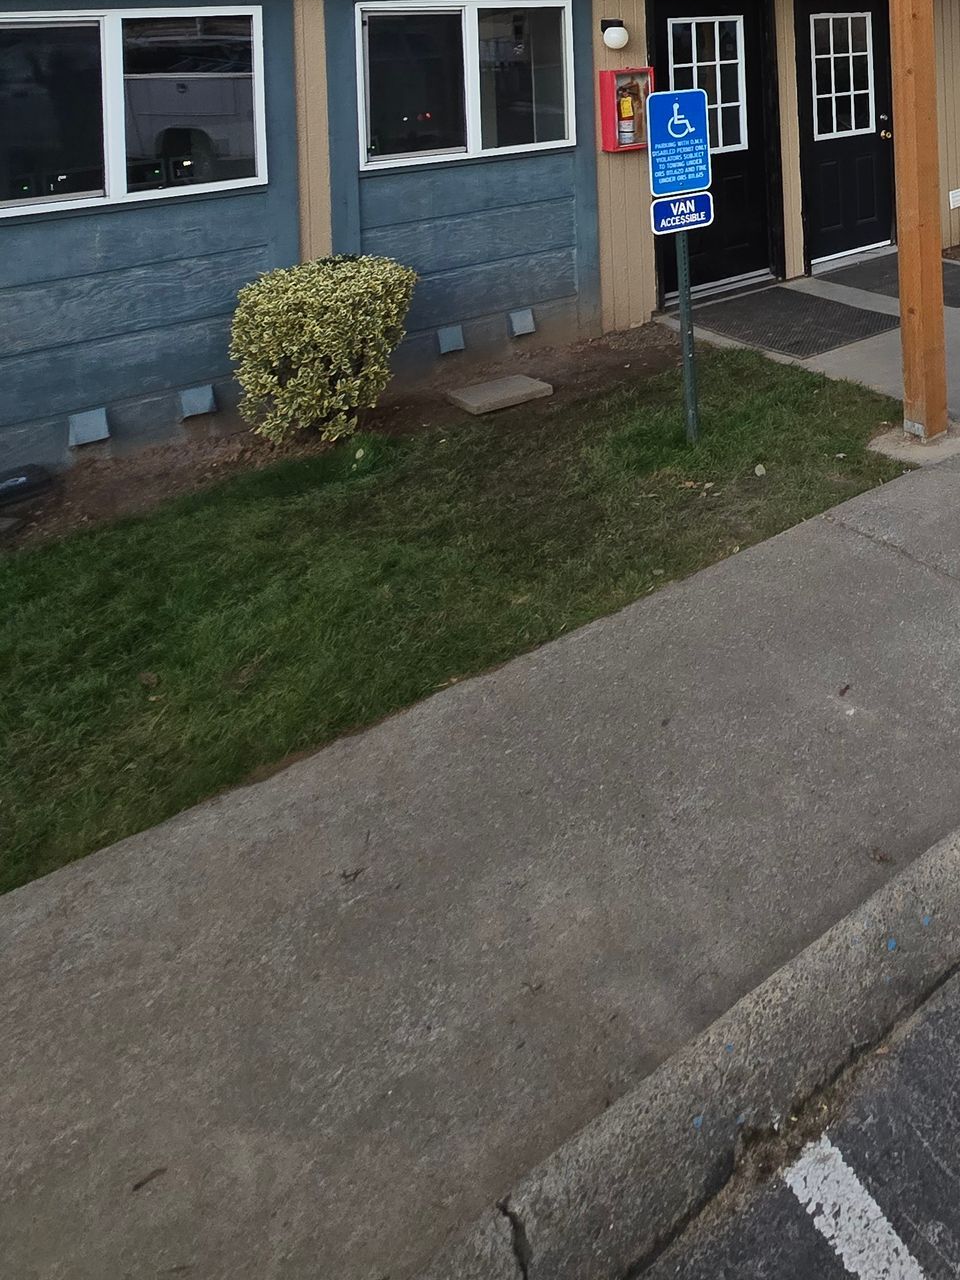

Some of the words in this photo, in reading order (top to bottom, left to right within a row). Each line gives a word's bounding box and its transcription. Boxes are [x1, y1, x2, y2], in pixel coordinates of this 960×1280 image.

[652, 149, 676, 157] DISABLED
[656, 155, 683, 163] VIOLATORS
[670, 200, 695, 216] VAN
[660, 212, 706, 228] ACCESSIBLE
